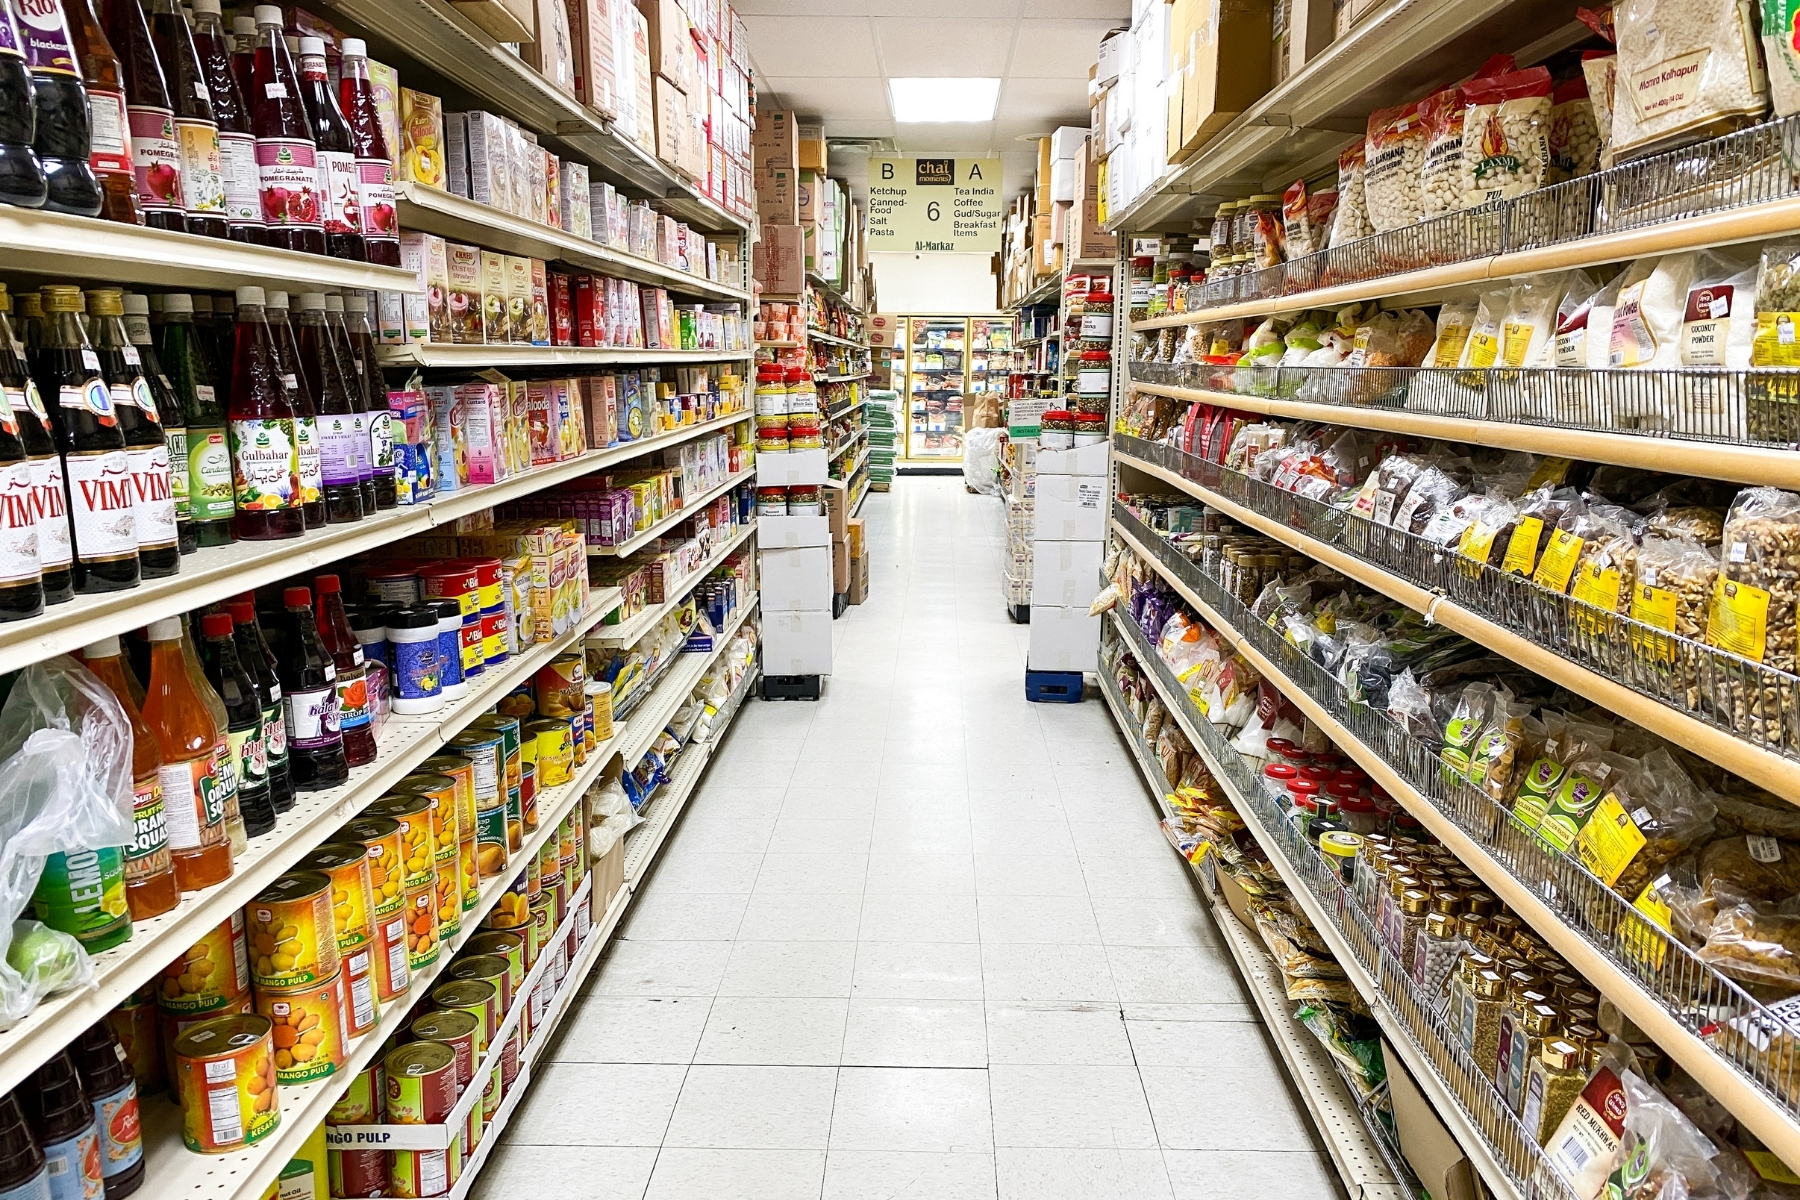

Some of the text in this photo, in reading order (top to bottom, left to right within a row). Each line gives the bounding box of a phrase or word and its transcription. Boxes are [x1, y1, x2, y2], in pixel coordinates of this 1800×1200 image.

[1638, 76, 1660, 92] Mamra
[1376, 145, 1406, 166] MAKHANA
[918, 160, 950, 174] chai
[1480, 156, 1515, 170] LAXMI
[882, 163, 894, 180] B
[968, 163, 983, 180] A
[260, 175, 314, 183] POMEGRANATE
[919, 175, 951, 183] moments
[870, 187, 907, 196] Ketchup
[954, 187, 995, 196] Tea India
[870, 198, 907, 206] Canned-
[954, 199, 983, 207] Coffee
[870, 206, 892, 214] Food
[927, 201, 940, 221] 6
[954, 210, 1001, 219] Gud/Sugar
[870, 217, 887, 225] Salt
[954, 221, 997, 229] Breakfast
[870, 228, 895, 236] Pasta
[954, 229, 978, 237] Items
[915, 241, 954, 251] Al-Markaz
[1691, 323, 1716, 333] COCONUT
[1691, 334, 1715, 344] POWDER
[242, 450, 288, 461] Gulbahar
[133, 789, 152, 804] Sun
[1544, 818, 1558, 830] GOLDEN
[341, 936, 359, 947] PULP
[260, 974, 309, 986] MANGO PULP
[166, 996, 220, 1010] MANGO PULP
[277, 1064, 330, 1079] MANGO PULP
[251, 1119, 273, 1138] KESAR
[1575, 1103, 1618, 1153] RED MUKHWAS
[326, 1132, 391, 1143] NGO PULP
